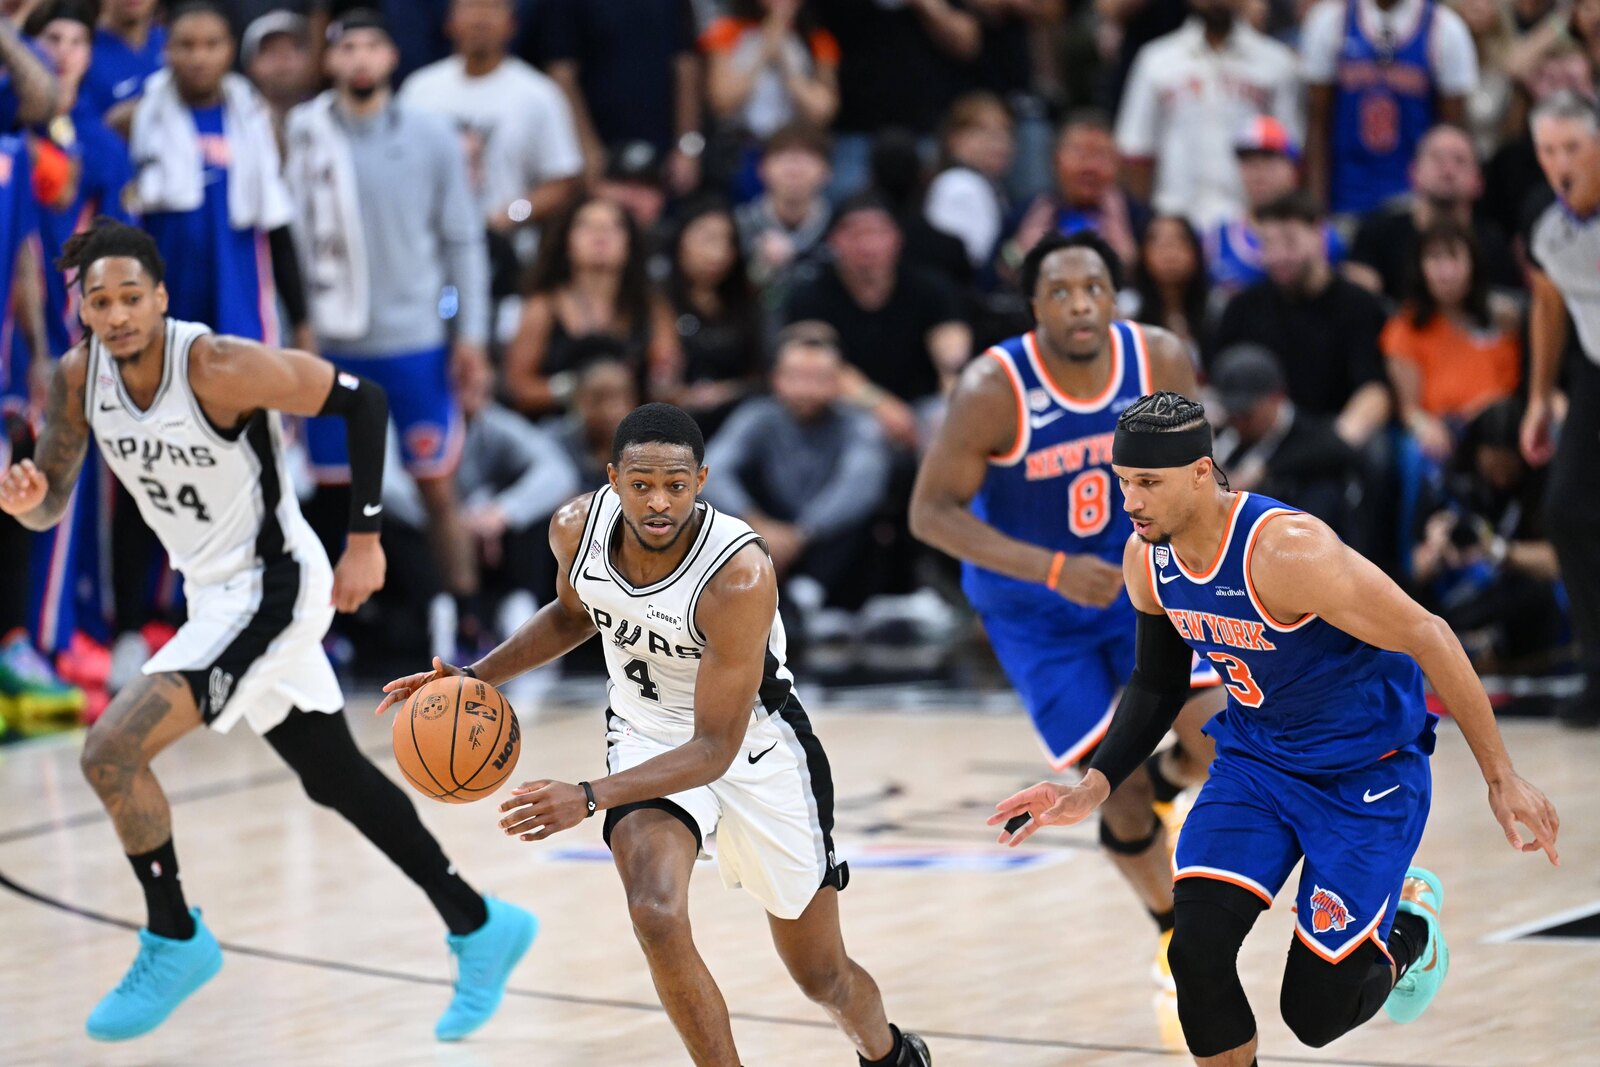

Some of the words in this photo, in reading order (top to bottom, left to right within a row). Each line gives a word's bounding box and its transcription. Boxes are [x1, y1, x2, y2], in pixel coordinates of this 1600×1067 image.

[1025, 438, 1087, 482] NEW
[138, 475, 212, 522] 24
[1068, 468, 1111, 538] 8
[582, 602, 701, 660] PURS
[651, 608, 678, 626] LEDGER
[1203, 611, 1277, 651] YORK
[622, 656, 661, 704] 4
[1207, 651, 1265, 708] 3
[1311, 891, 1347, 929] KNICKS
